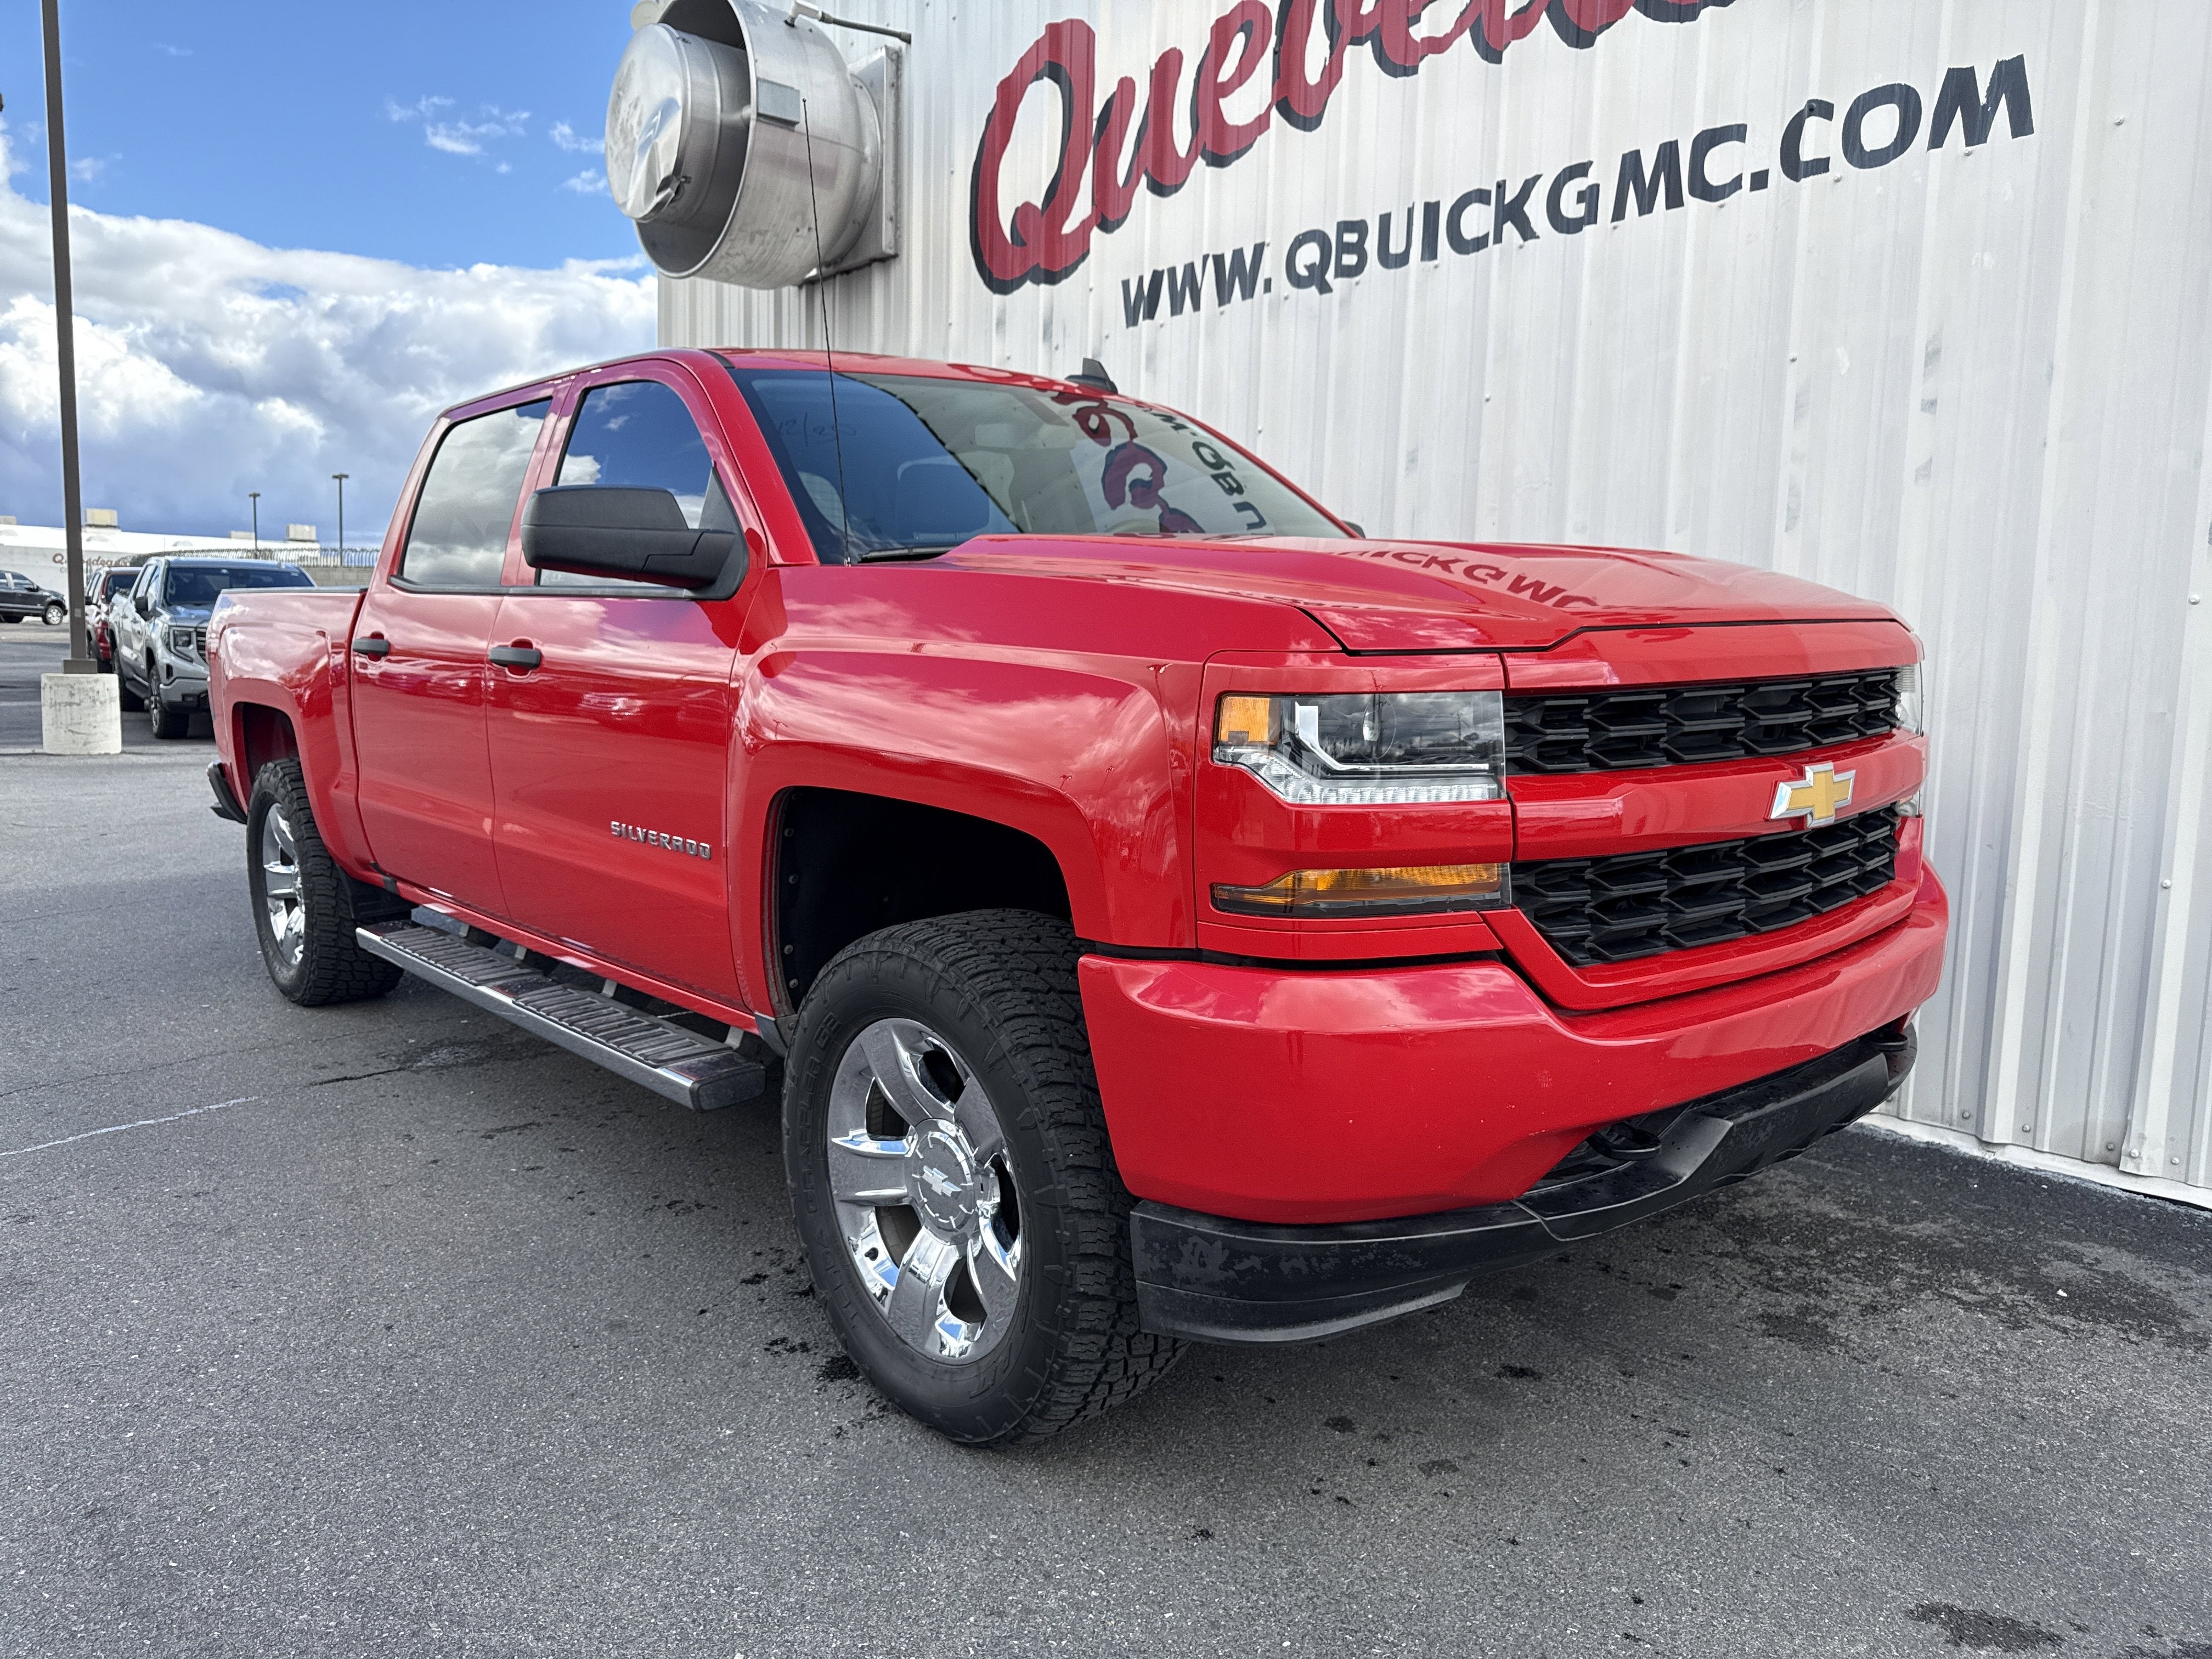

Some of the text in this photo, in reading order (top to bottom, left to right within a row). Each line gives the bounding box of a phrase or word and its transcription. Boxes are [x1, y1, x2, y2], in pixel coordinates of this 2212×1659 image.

[1121, 54, 2035, 328] WWW.QBUICKGMC.COM
[610, 820, 712, 860] SILVERADO
[798, 1057, 821, 1215] GRAPPLER
[814, 1012, 843, 1051] G2
